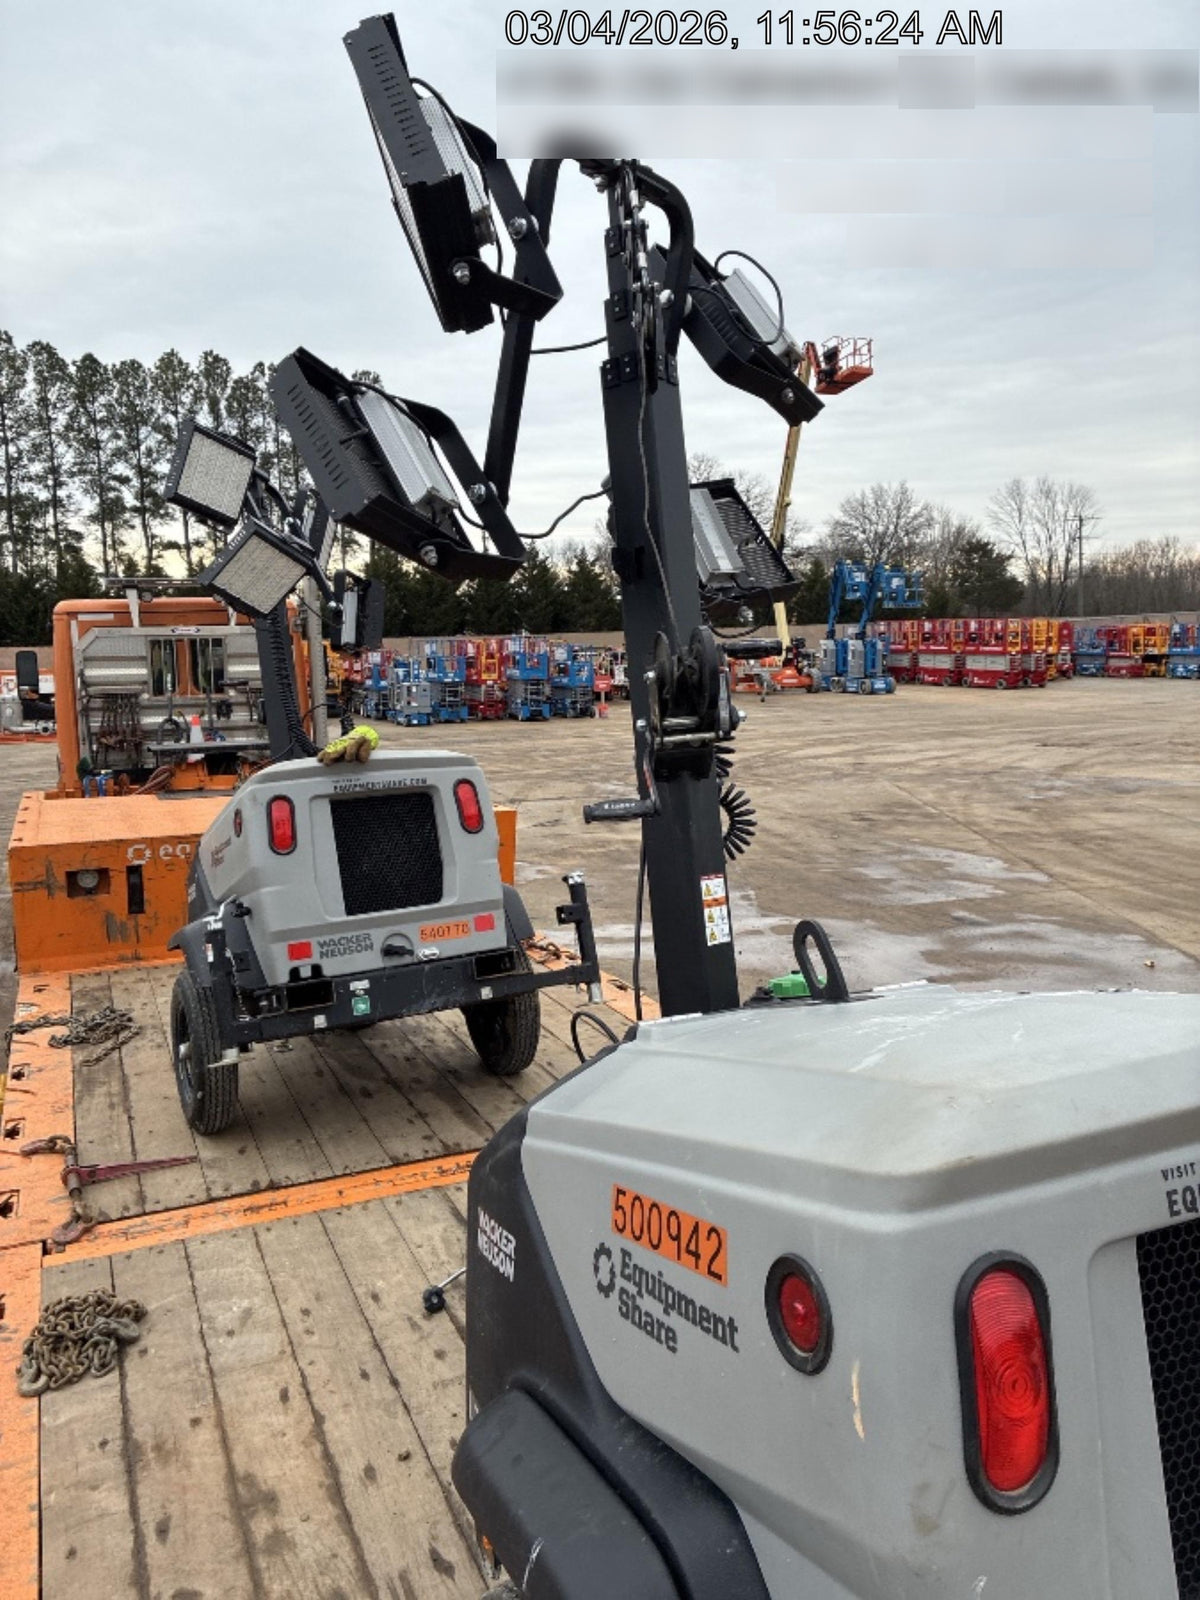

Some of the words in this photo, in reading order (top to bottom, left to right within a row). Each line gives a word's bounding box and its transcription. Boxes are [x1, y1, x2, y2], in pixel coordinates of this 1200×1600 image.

[317, 932, 373, 950] WACKER
[319, 942, 374, 959] NEUSON
[1161, 1162, 1196, 1181] VISIT
[1166, 1183, 1200, 1218] EQ
[478, 1206, 516, 1260] WACKER
[614, 1187, 723, 1281] 500942
[478, 1231, 515, 1283] NEUSON
[620, 1247, 740, 1353] Equipment
